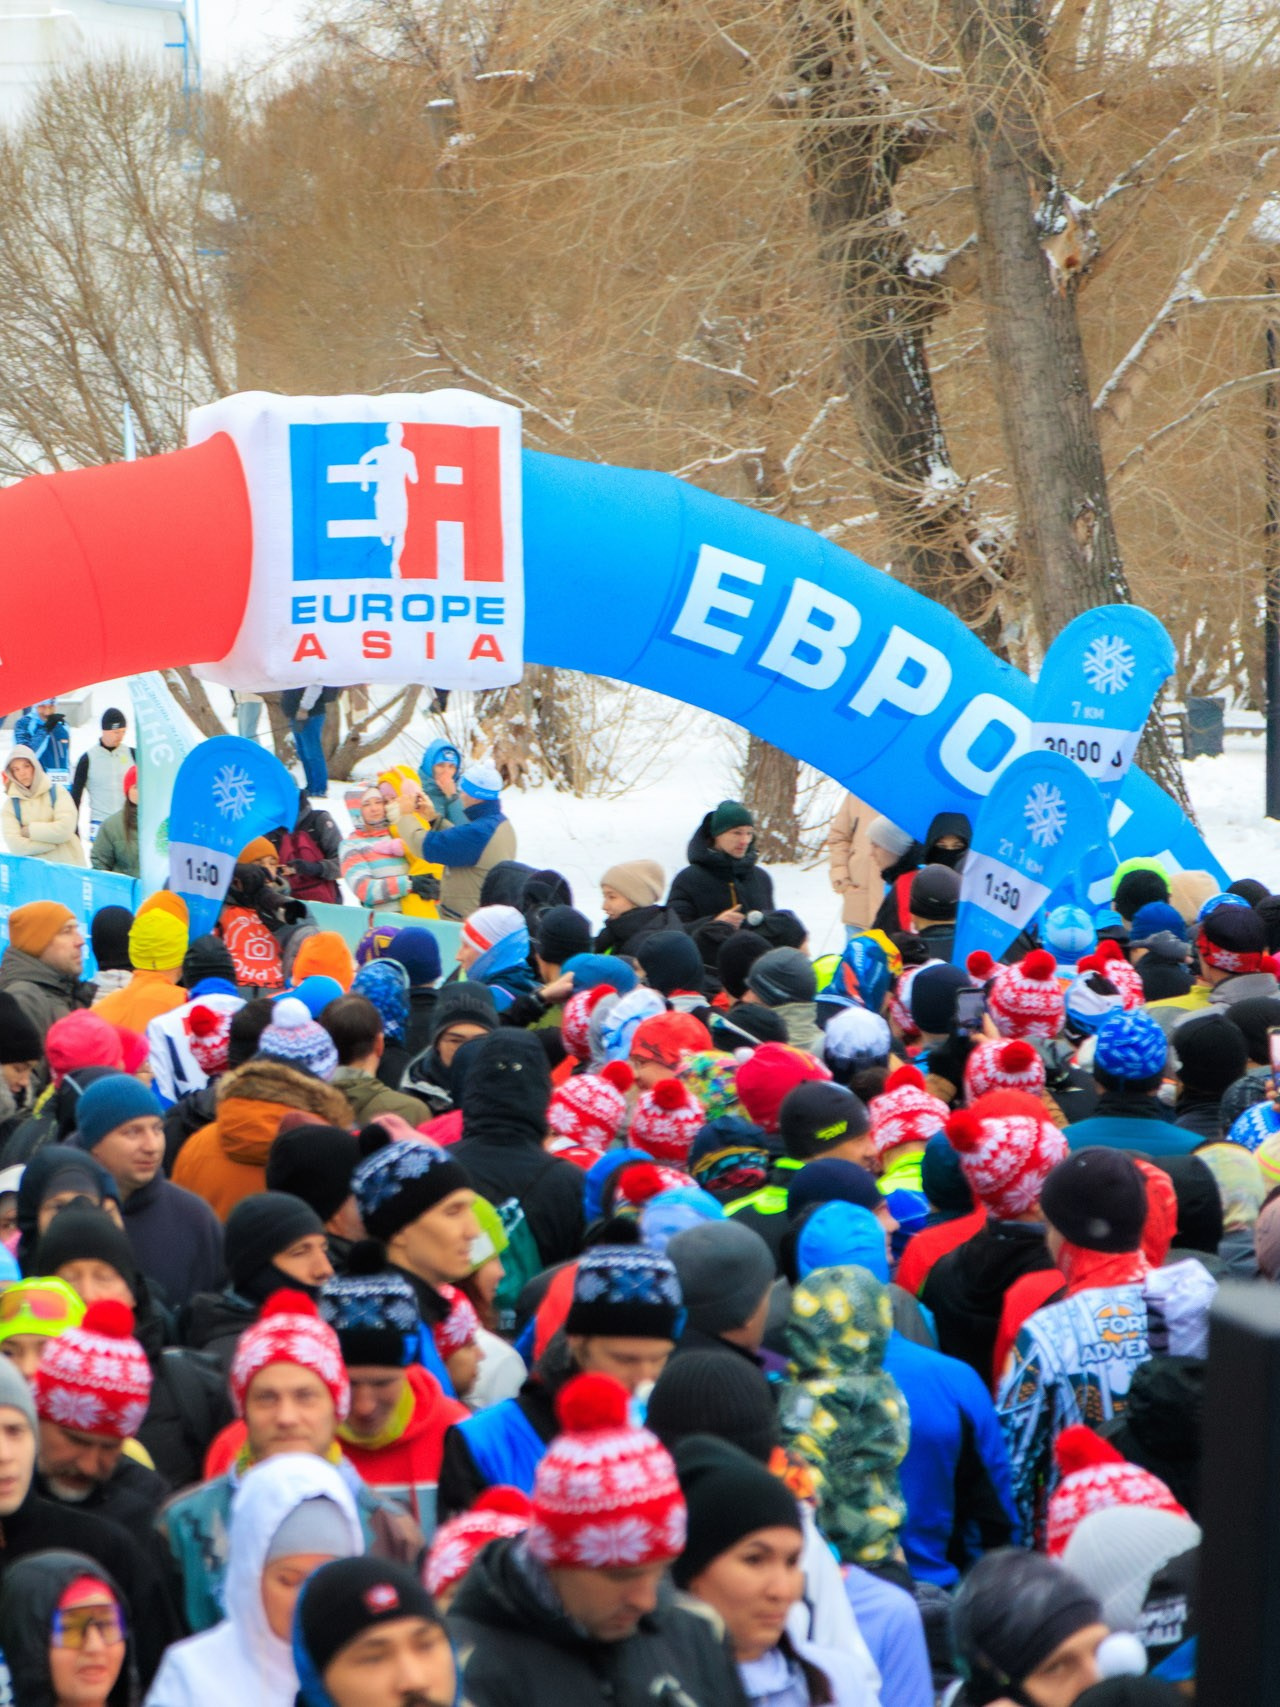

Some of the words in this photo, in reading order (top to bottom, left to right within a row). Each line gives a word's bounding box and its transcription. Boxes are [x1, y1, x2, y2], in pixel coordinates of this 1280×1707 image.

[291, 593, 506, 626] EUROPE
[292, 629, 506, 663] ASIA
[1071, 701, 1082, 719] 7
[984, 872, 1021, 911] 1:30
